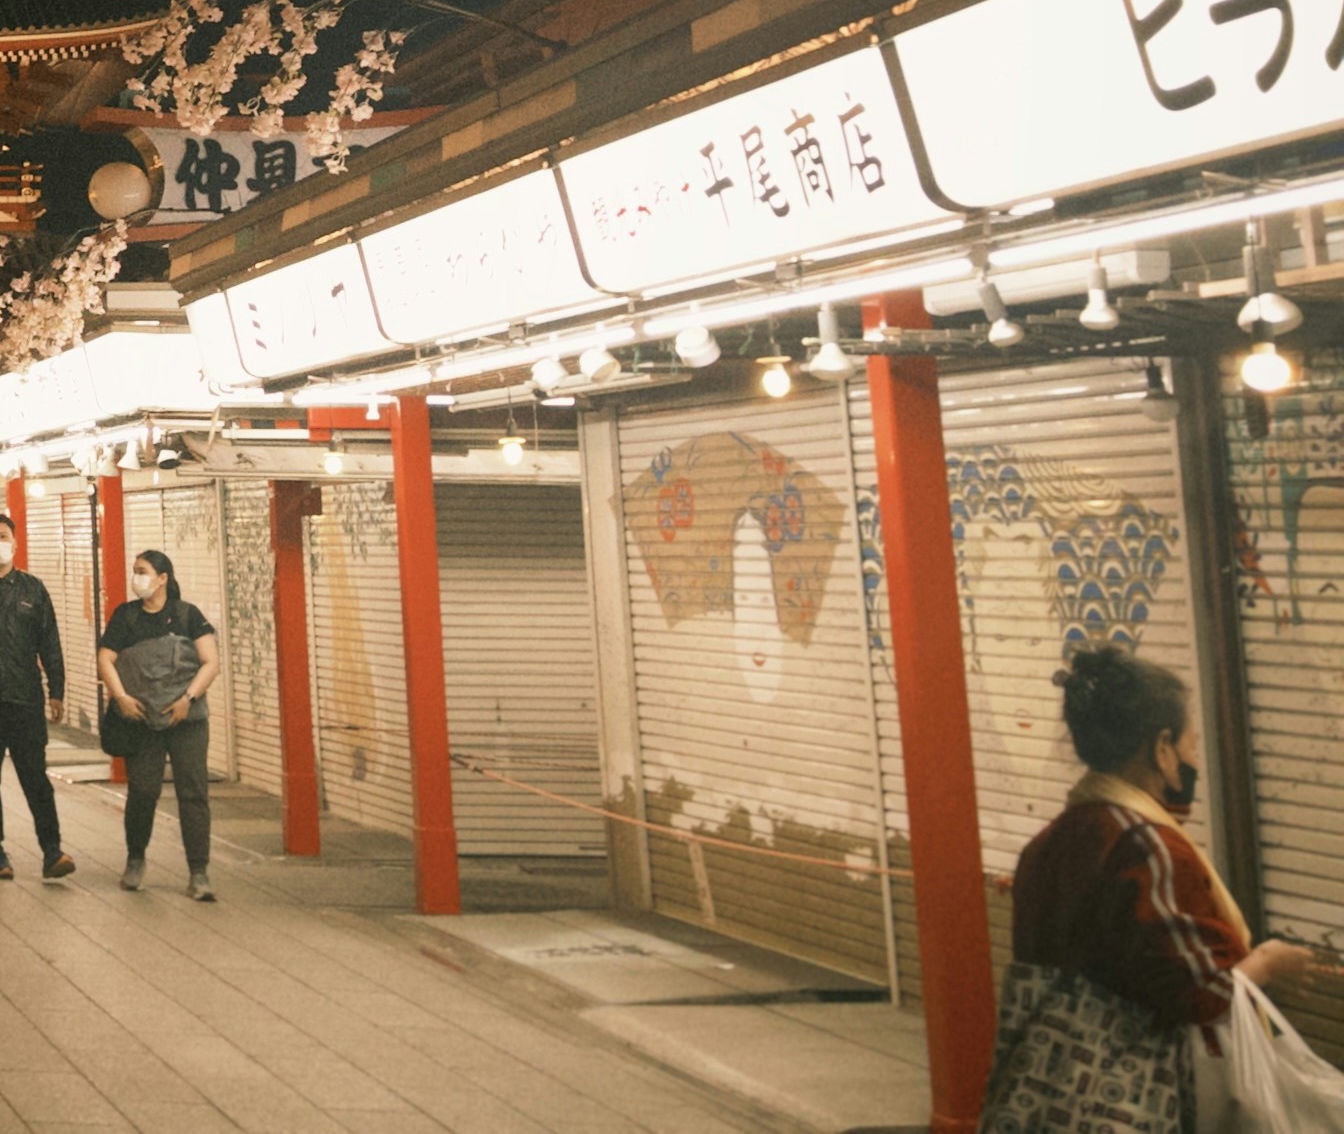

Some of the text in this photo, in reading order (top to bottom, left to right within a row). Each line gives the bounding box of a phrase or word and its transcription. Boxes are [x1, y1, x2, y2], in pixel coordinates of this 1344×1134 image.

[175, 137, 369, 213] 仲見
[699, 91, 887, 230] 平尾商店
